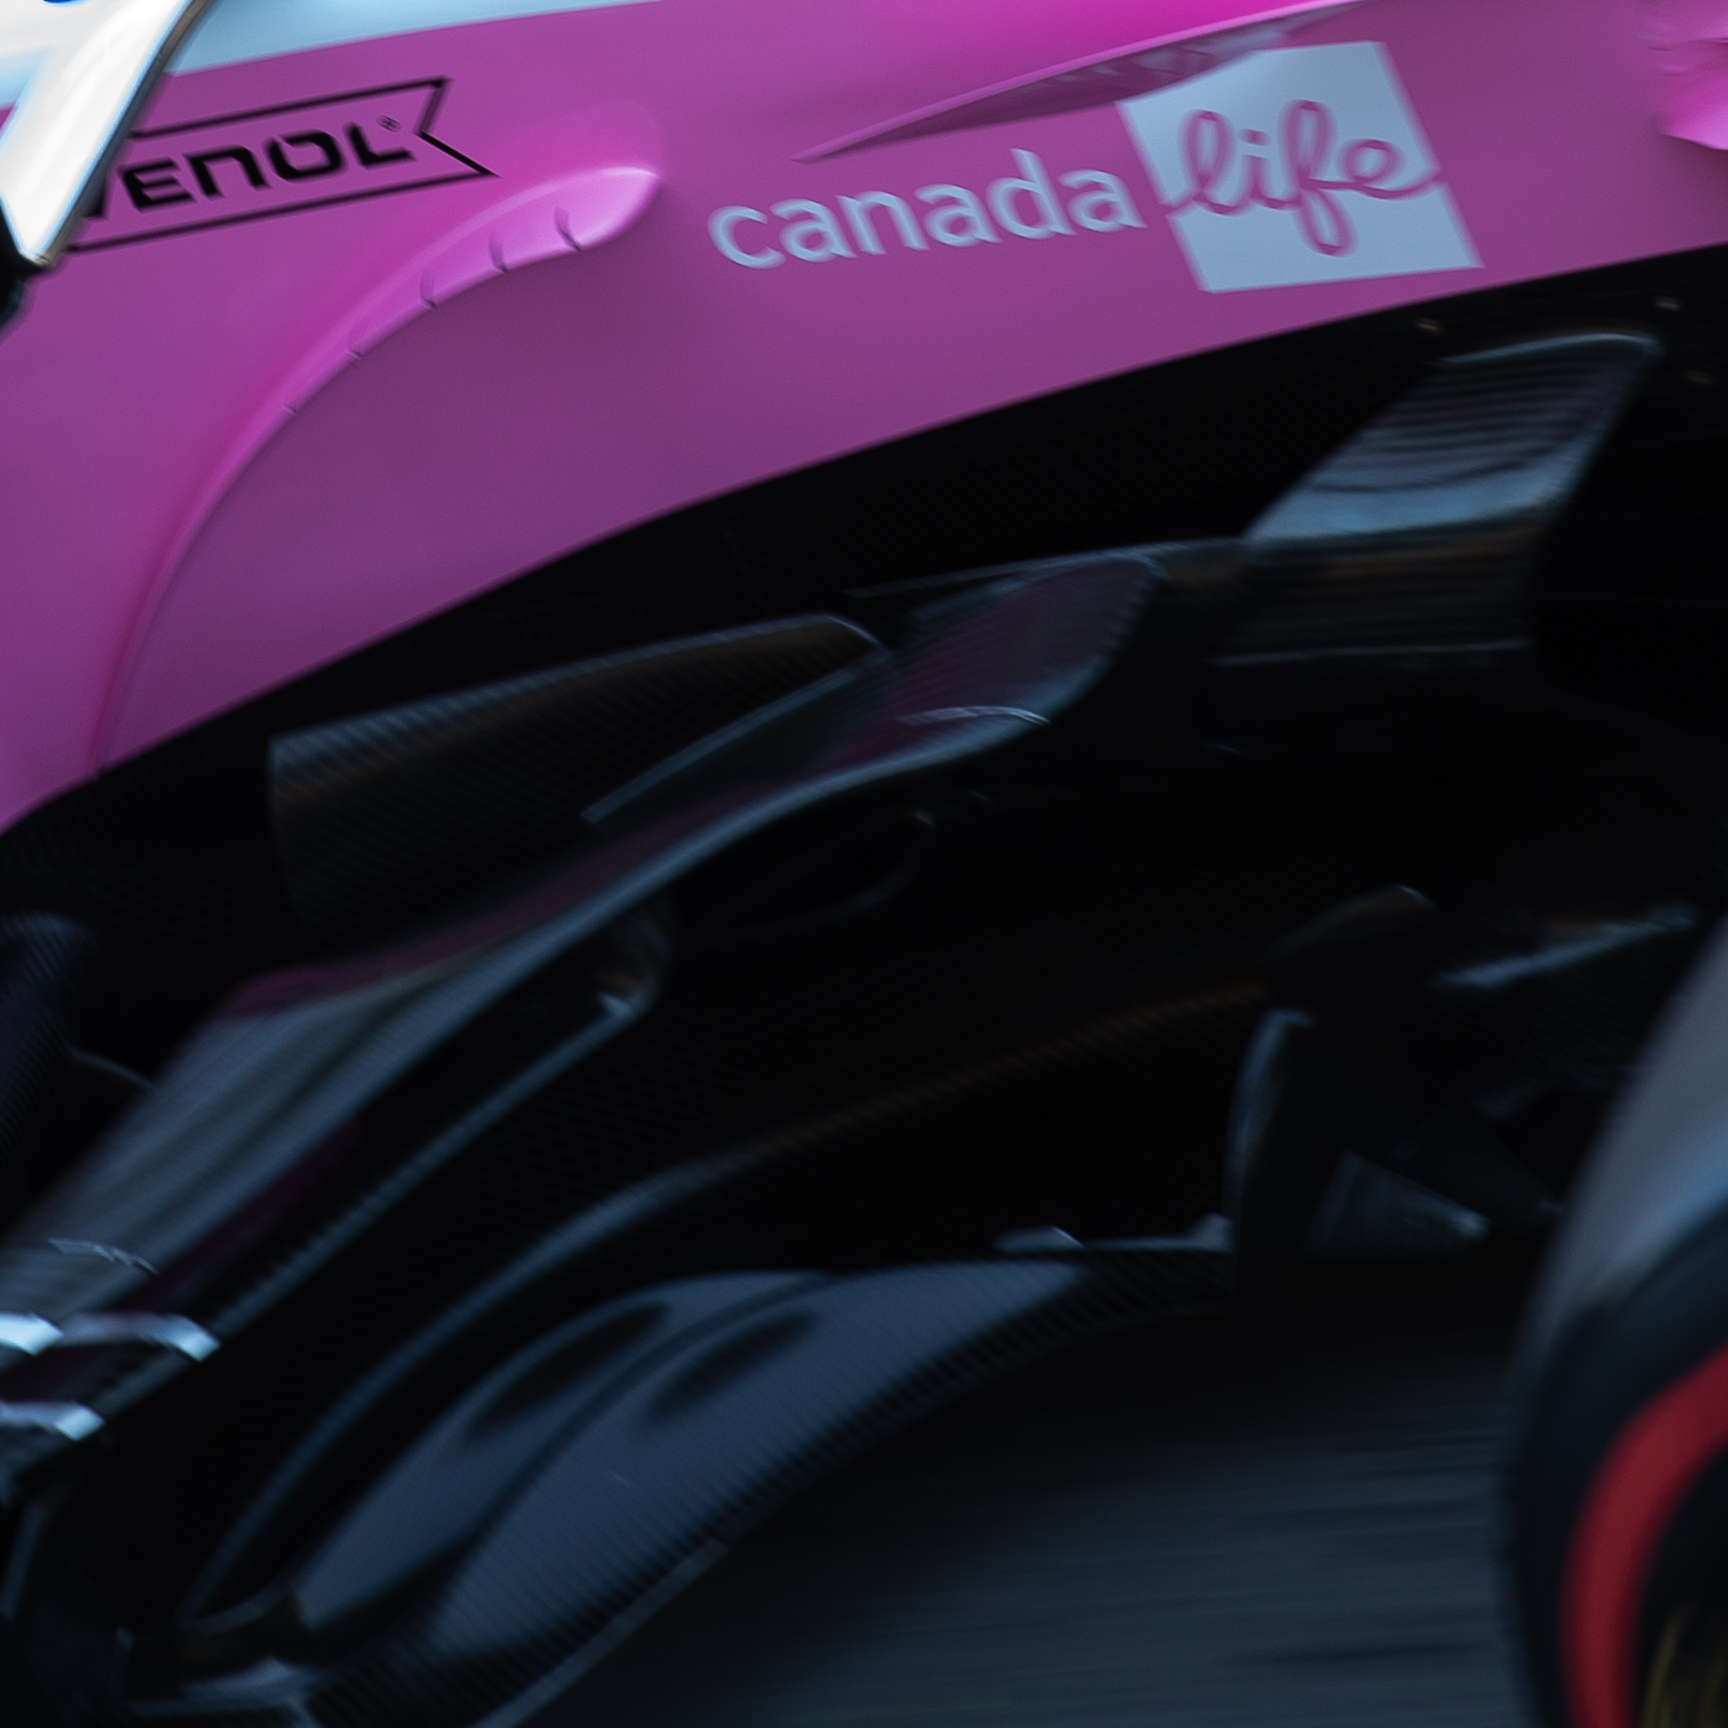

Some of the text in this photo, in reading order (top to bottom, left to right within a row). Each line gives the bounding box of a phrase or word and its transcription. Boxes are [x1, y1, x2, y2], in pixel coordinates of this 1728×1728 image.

[81, 120, 417, 220] ENOL
[707, 99, 1446, 269] canada life
